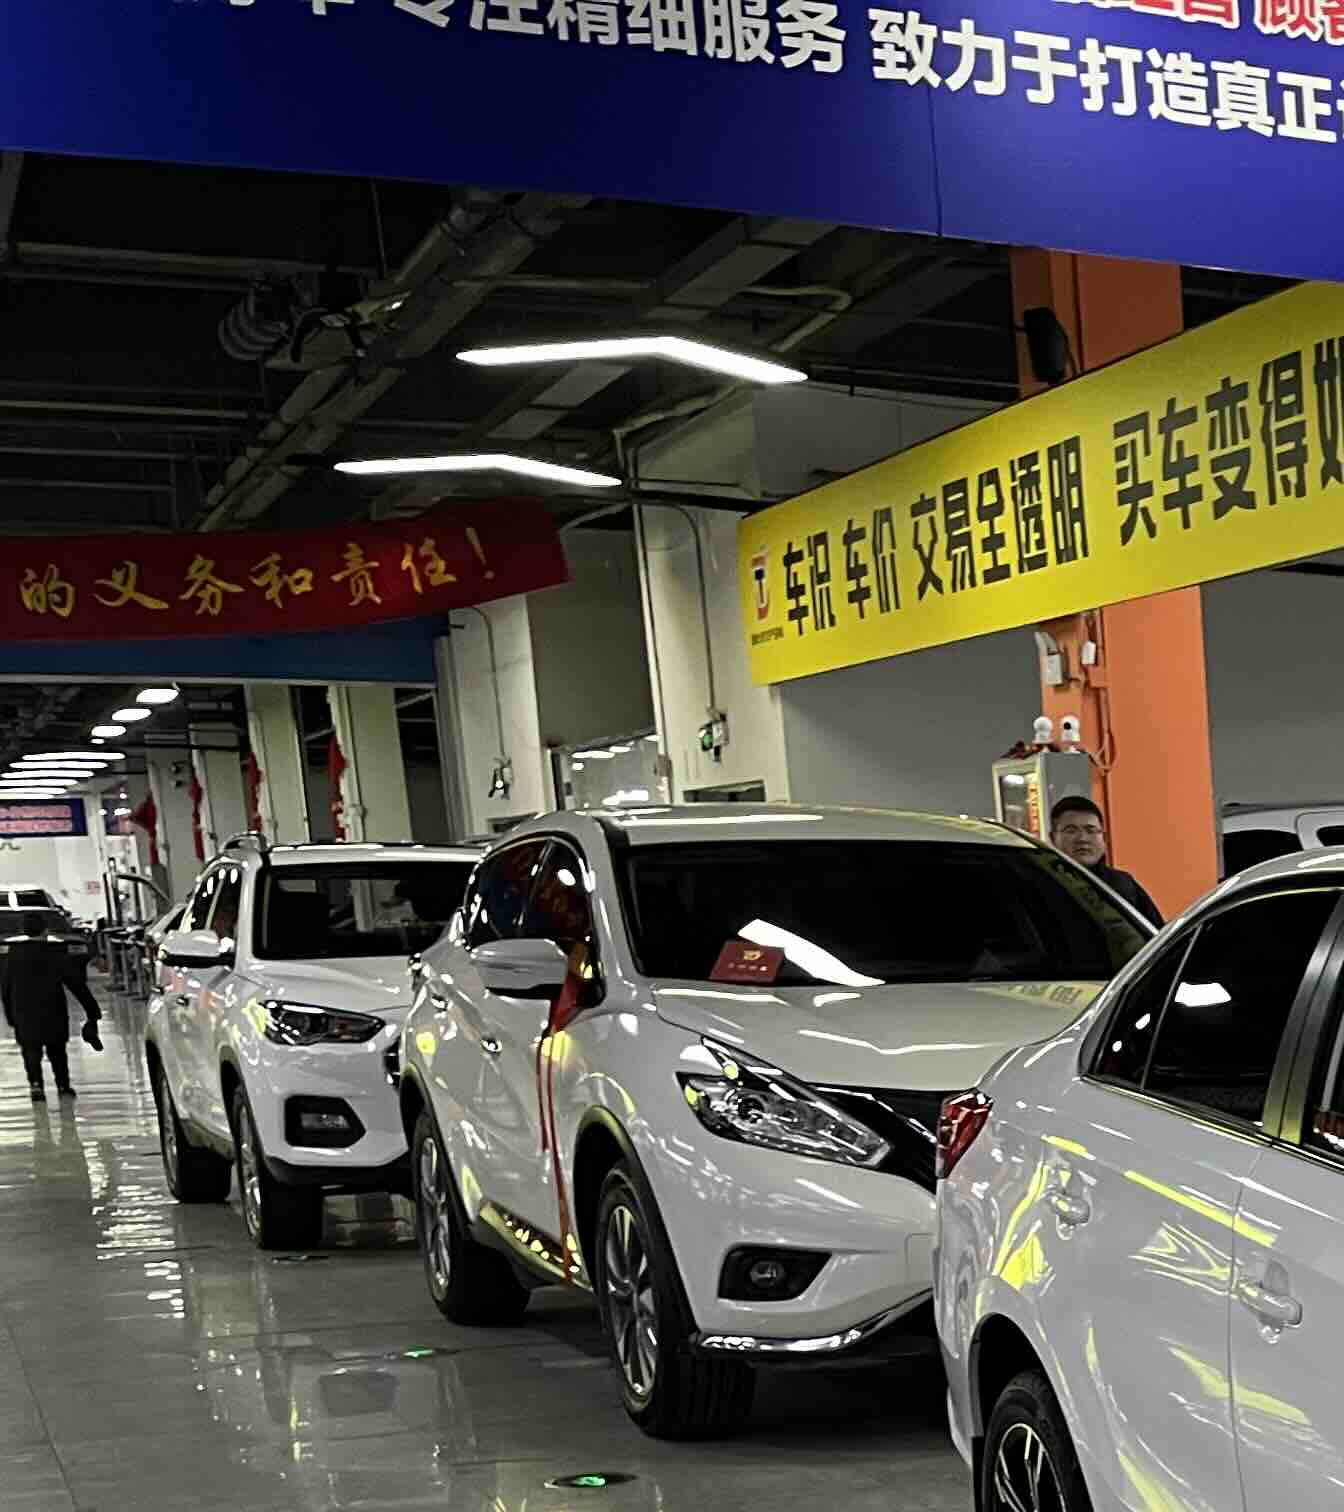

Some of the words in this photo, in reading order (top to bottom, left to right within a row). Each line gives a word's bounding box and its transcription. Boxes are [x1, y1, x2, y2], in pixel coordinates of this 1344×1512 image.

[843, 506, 901, 619] 车价
[911, 435, 1090, 601] 交易全透明
